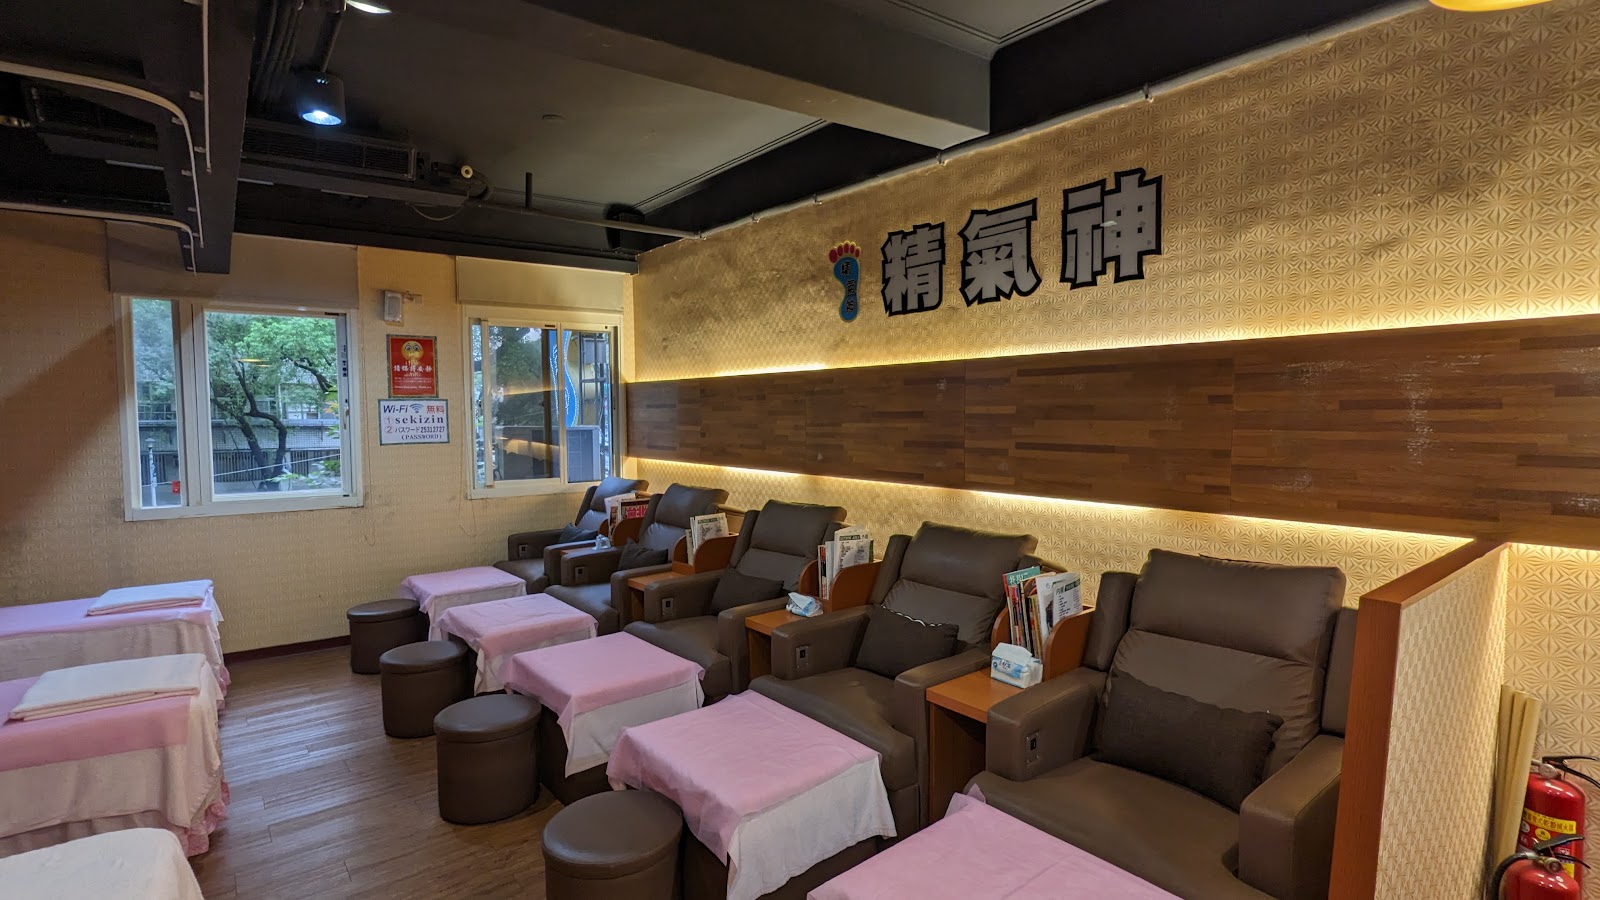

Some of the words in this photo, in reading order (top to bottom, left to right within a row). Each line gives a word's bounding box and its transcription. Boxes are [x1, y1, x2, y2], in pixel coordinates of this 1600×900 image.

[881, 168, 1162, 317] 精氣神
[383, 405, 409, 413] Wi-Fi
[426, 405, 445, 414] 無料
[395, 415, 444, 424] sekizin
